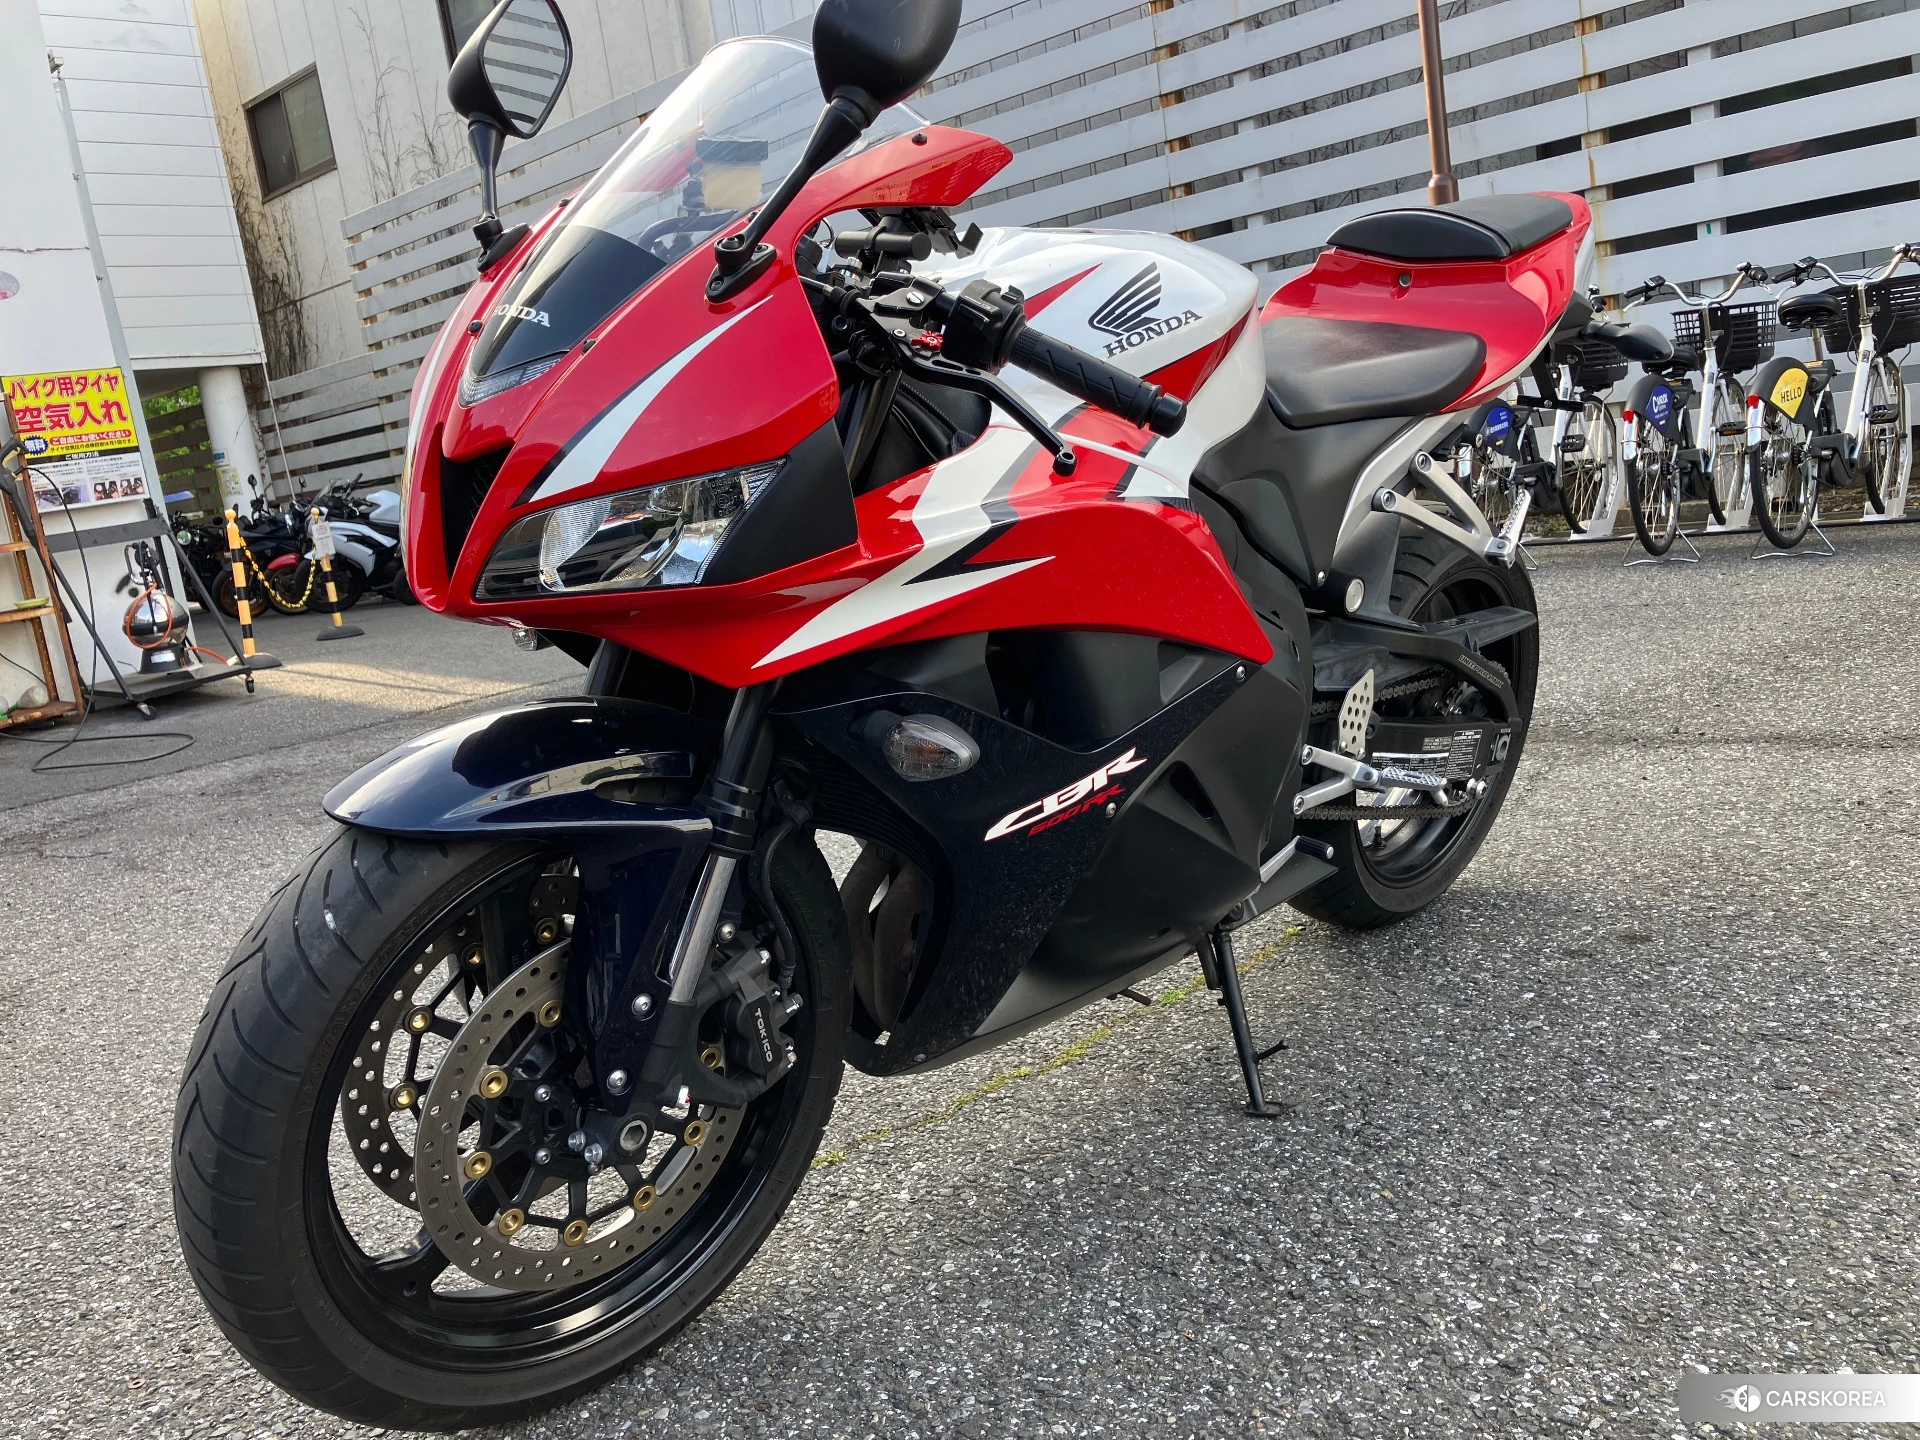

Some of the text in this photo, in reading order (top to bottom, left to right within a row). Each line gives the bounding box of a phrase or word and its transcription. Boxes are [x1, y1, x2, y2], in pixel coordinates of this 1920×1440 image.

[1103, 309, 1203, 359] HONDA
[10, 373, 119, 400] バイク用タイヤ
[1781, 386, 1803, 404] HELLO
[14, 398, 128, 434] 空気入れ
[24, 438, 46, 453] 無料
[52, 431, 129, 445] ご自由にお使いください
[984, 745, 1148, 842] CBR
[1028, 783, 1126, 837] 600RR
[754, 1007, 773, 1063] TOKICO
